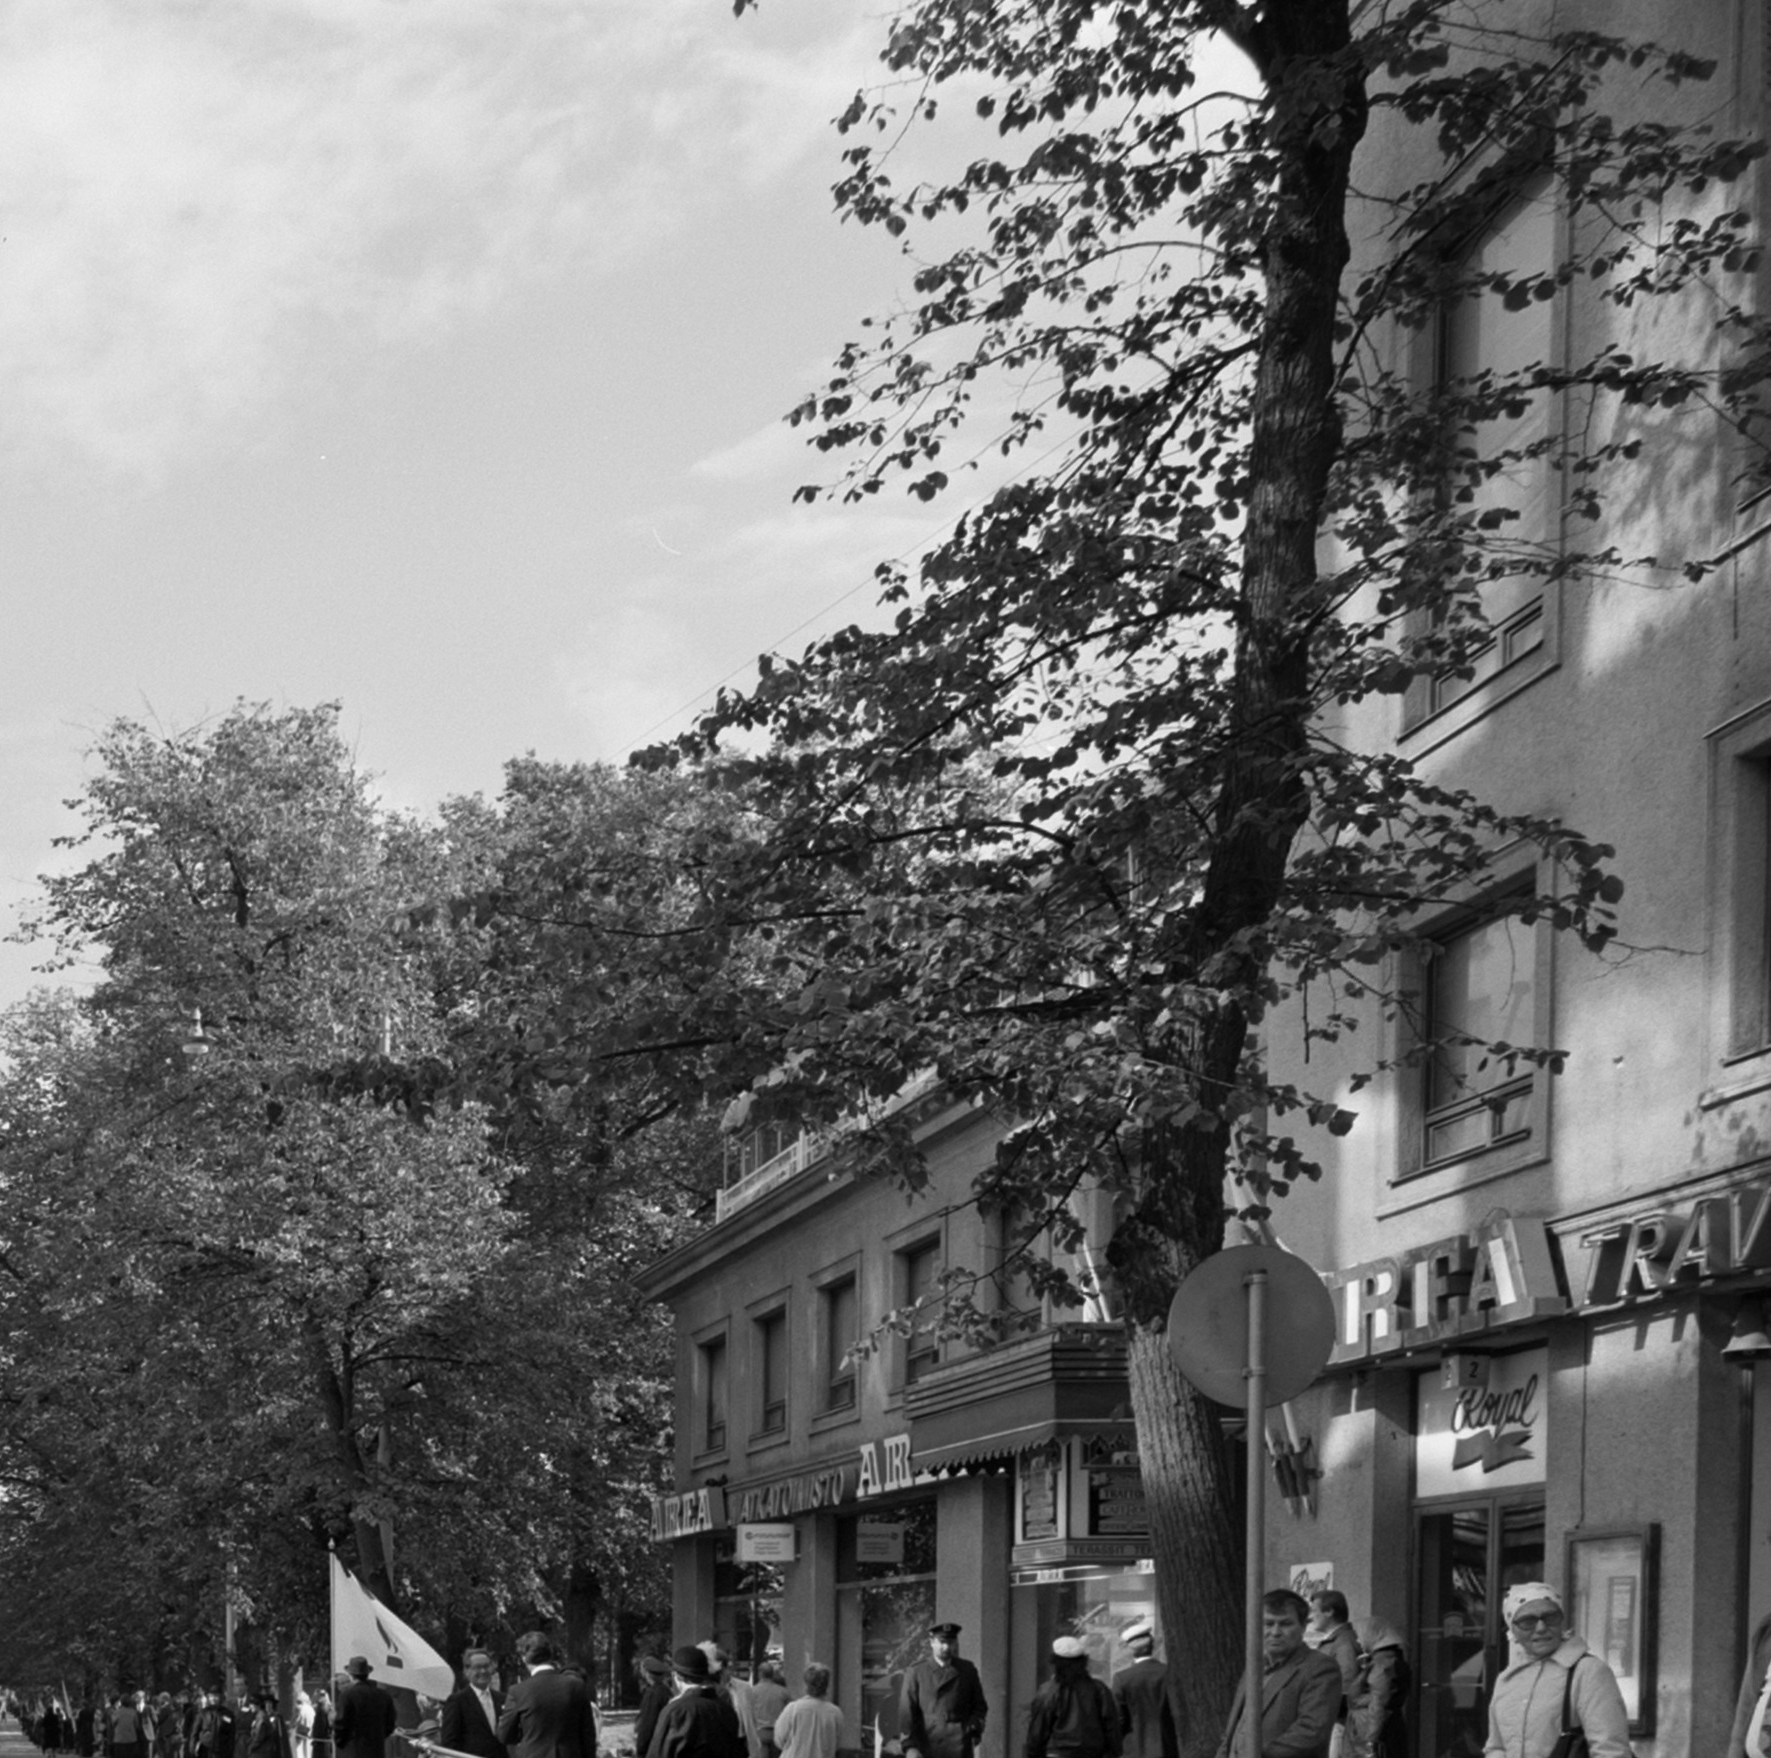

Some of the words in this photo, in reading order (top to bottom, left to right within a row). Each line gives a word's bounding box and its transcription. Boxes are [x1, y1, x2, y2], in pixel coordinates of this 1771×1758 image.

[1326, 1218, 1533, 1365] REA
[1469, 1361, 1479, 1378] 2
[1451, 1373, 1539, 1440] Royal
[648, 1487, 713, 1543] AREA
